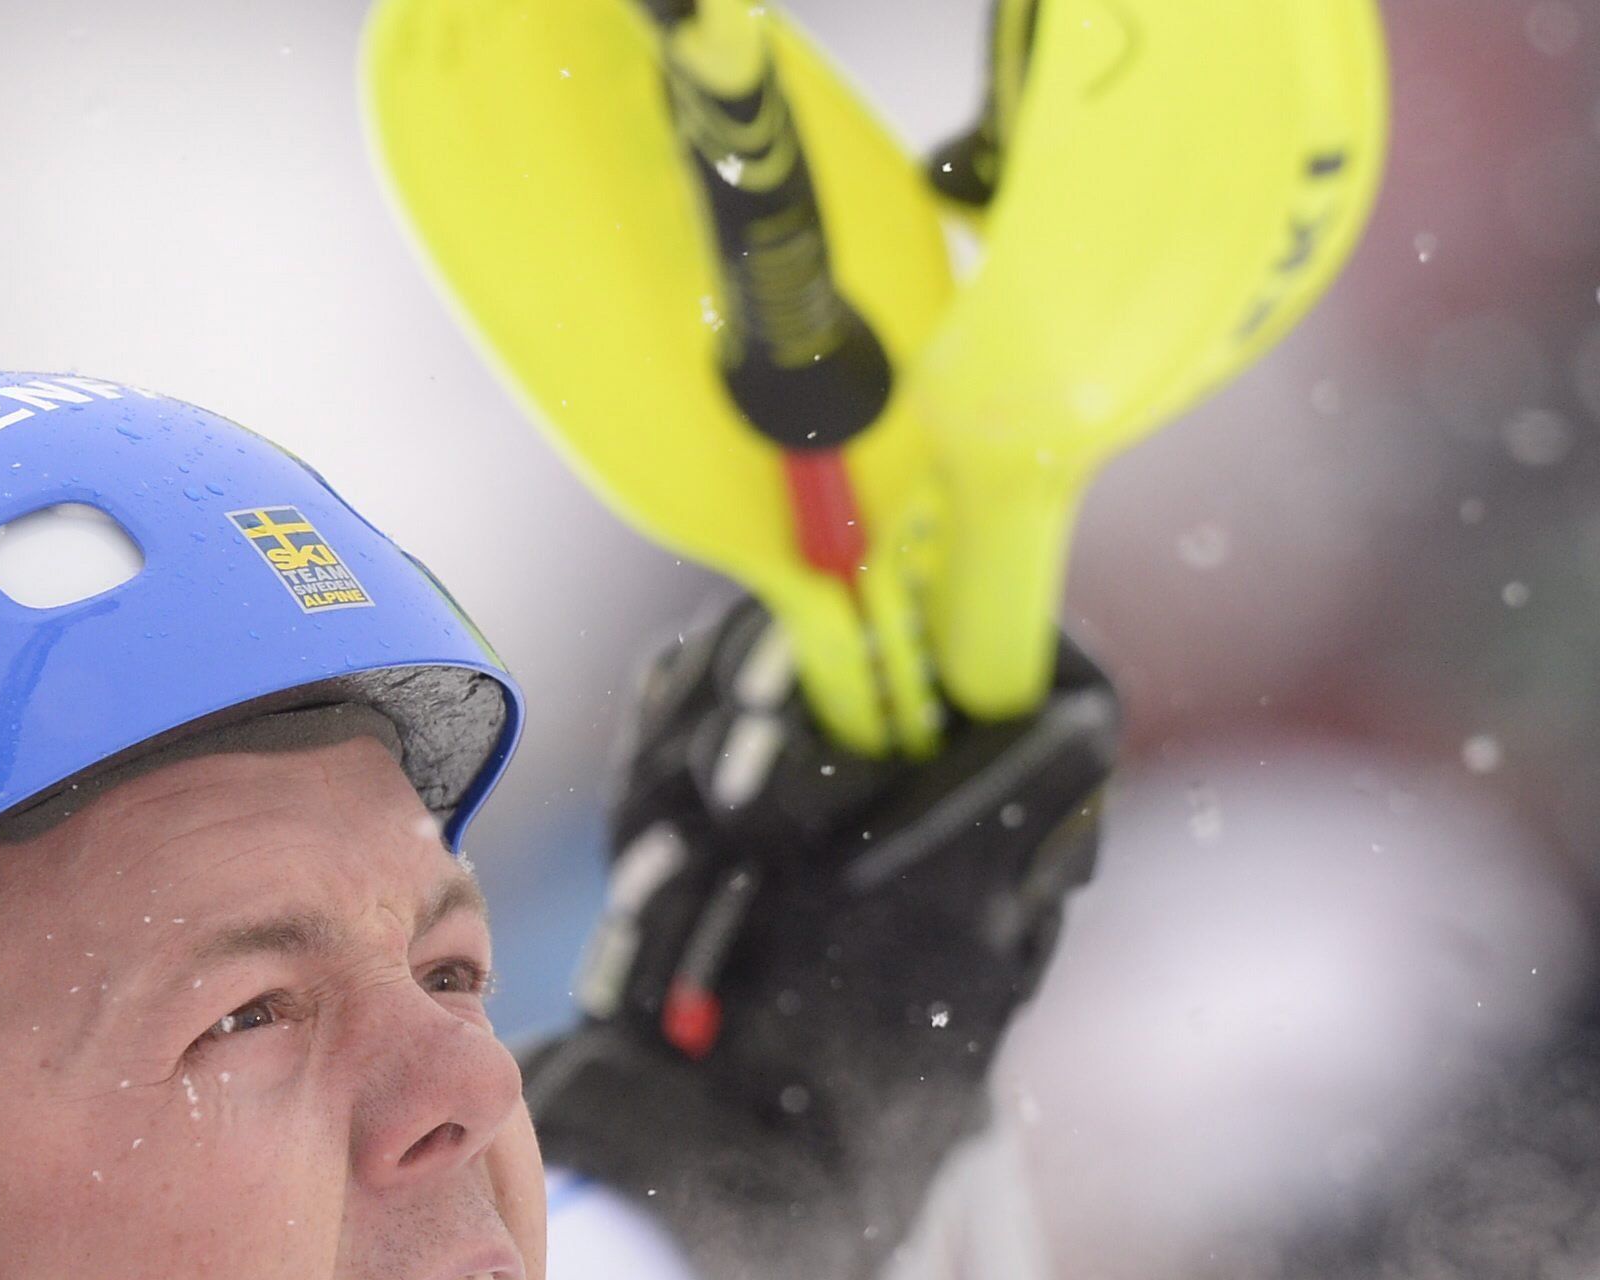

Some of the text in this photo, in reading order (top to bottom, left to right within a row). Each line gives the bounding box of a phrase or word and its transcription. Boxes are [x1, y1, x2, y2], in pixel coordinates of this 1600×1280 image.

[266, 544, 338, 571] SKI
[281, 564, 351, 585] TEAM
[293, 579, 358, 596] SWEDEN
[302, 588, 367, 608] ALPINE
